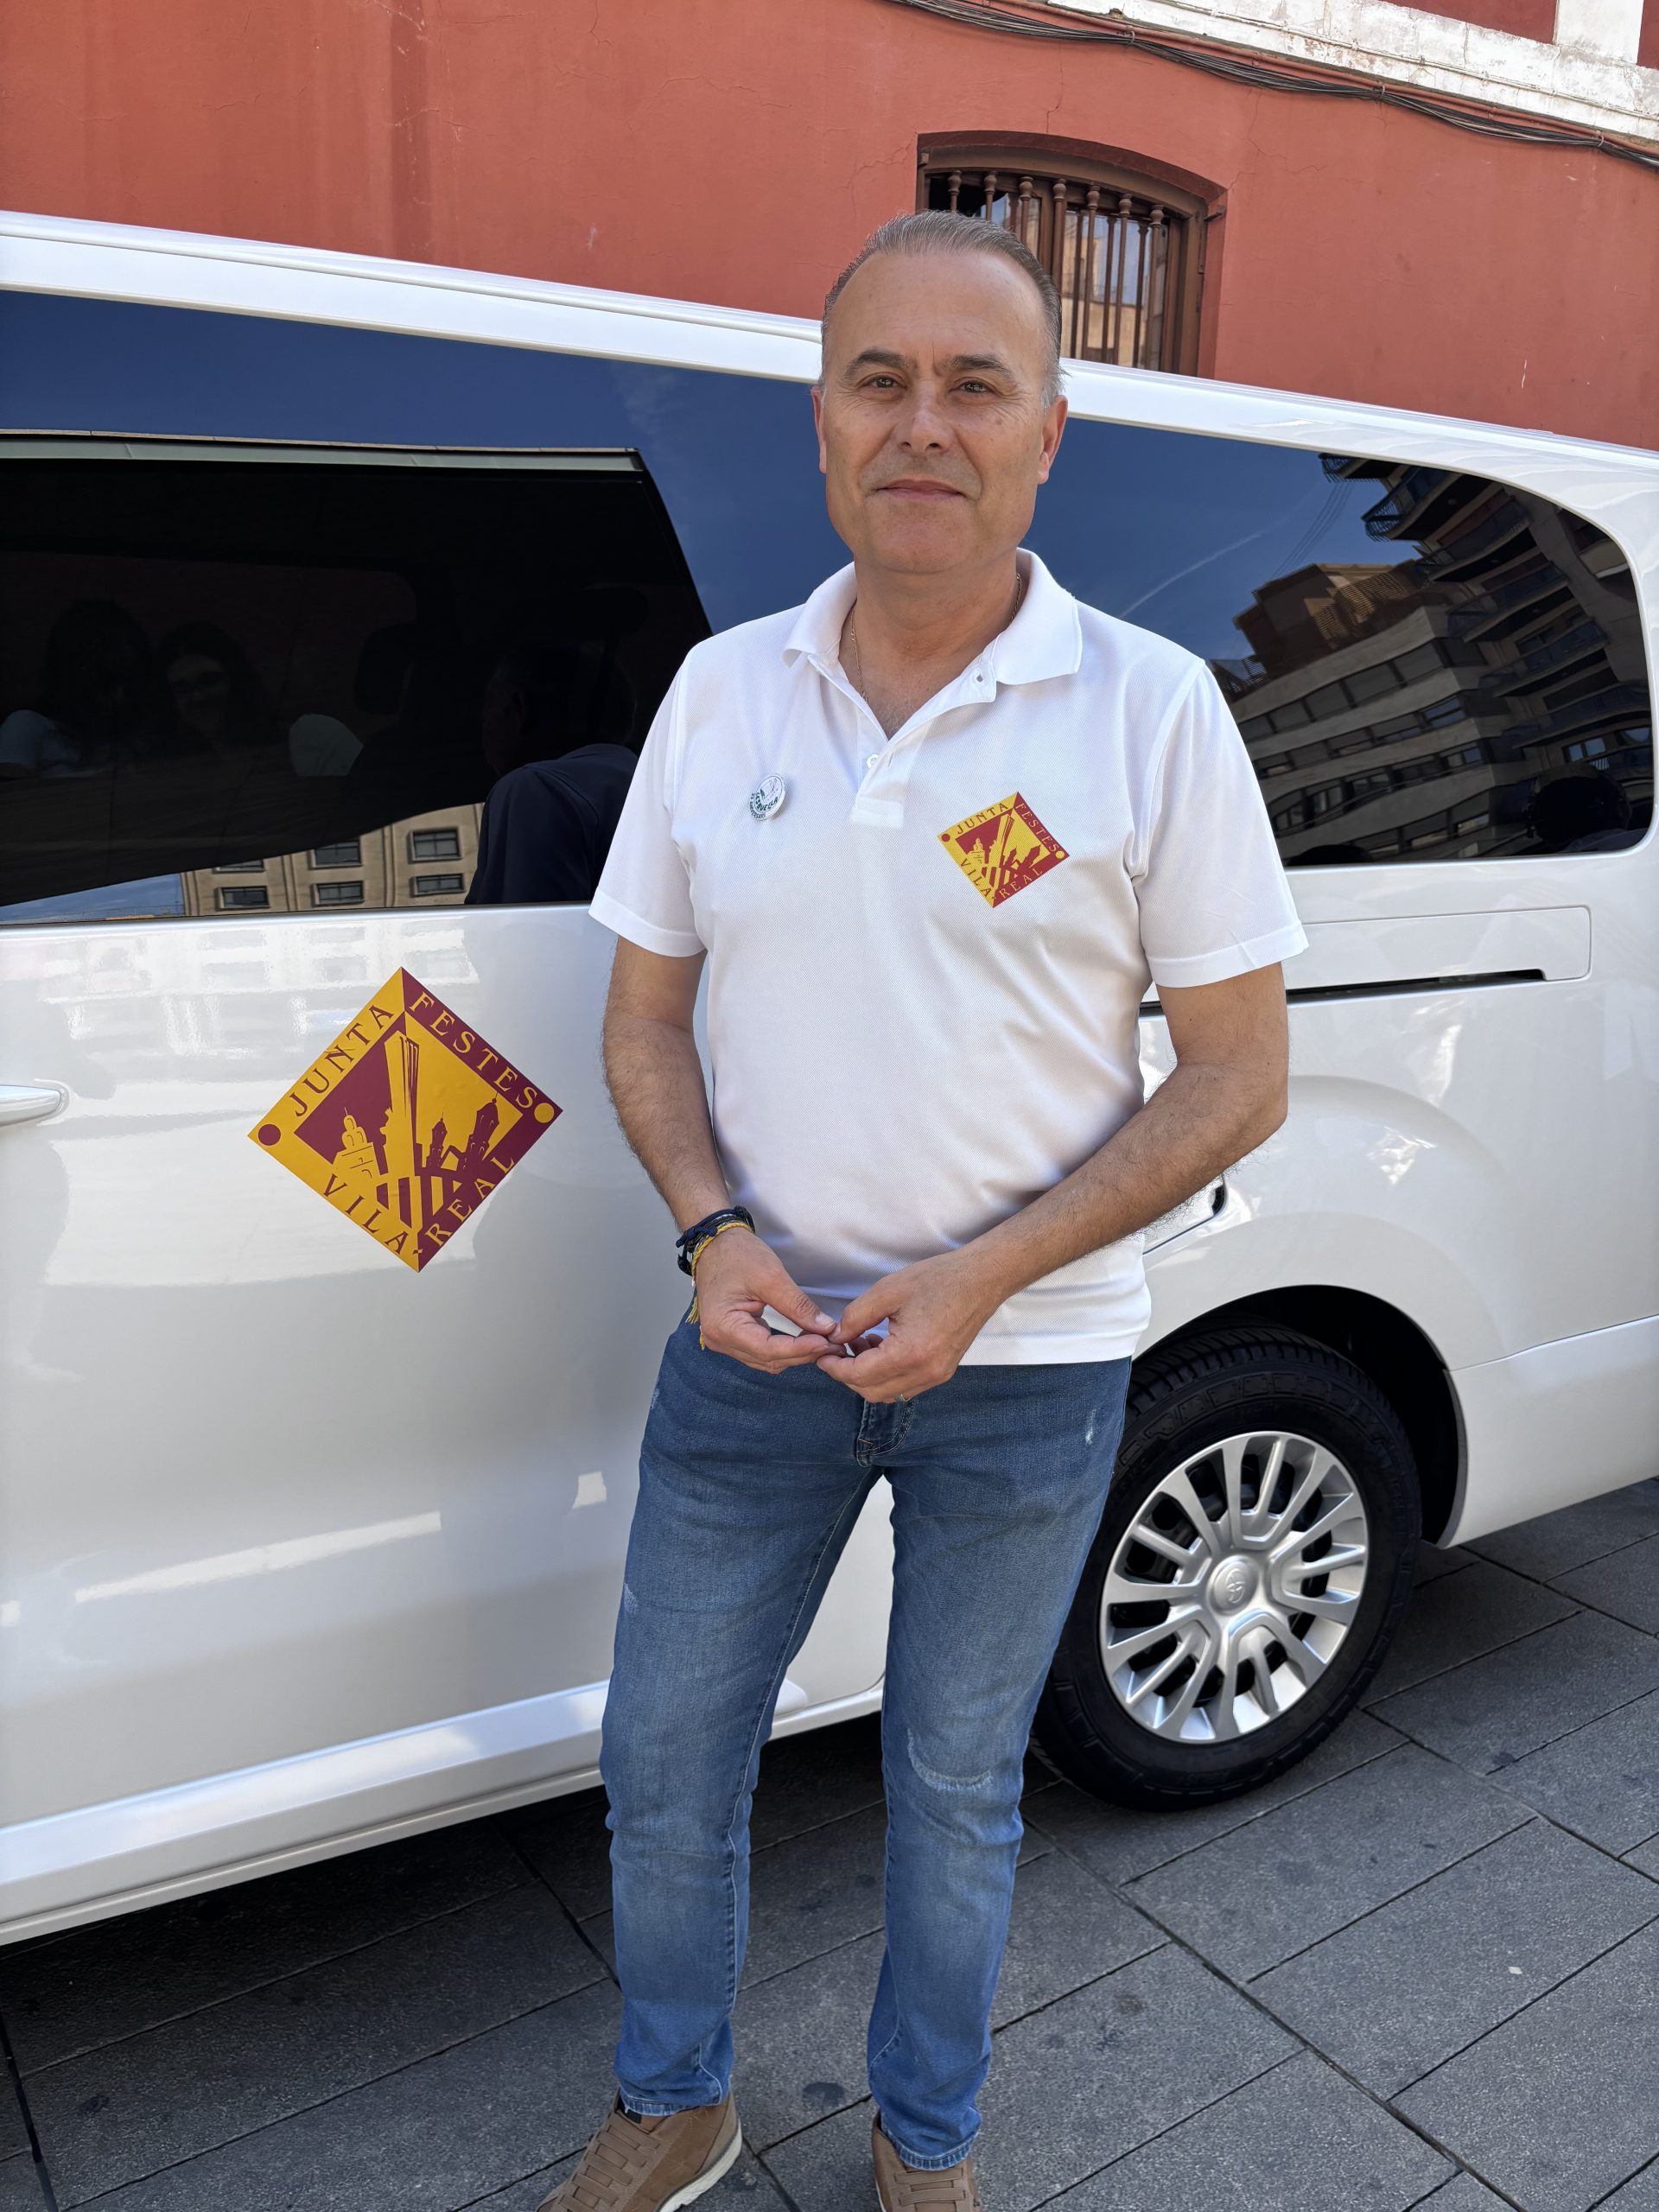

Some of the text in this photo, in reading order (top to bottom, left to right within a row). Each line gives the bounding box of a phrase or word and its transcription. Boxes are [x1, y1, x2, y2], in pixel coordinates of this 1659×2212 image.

[956, 802, 1009, 835] JUNTA
[1015, 803, 1059, 852] FESTES
[289, 1005, 395, 1117] JUNTA
[409, 991, 538, 1109] FESTES
